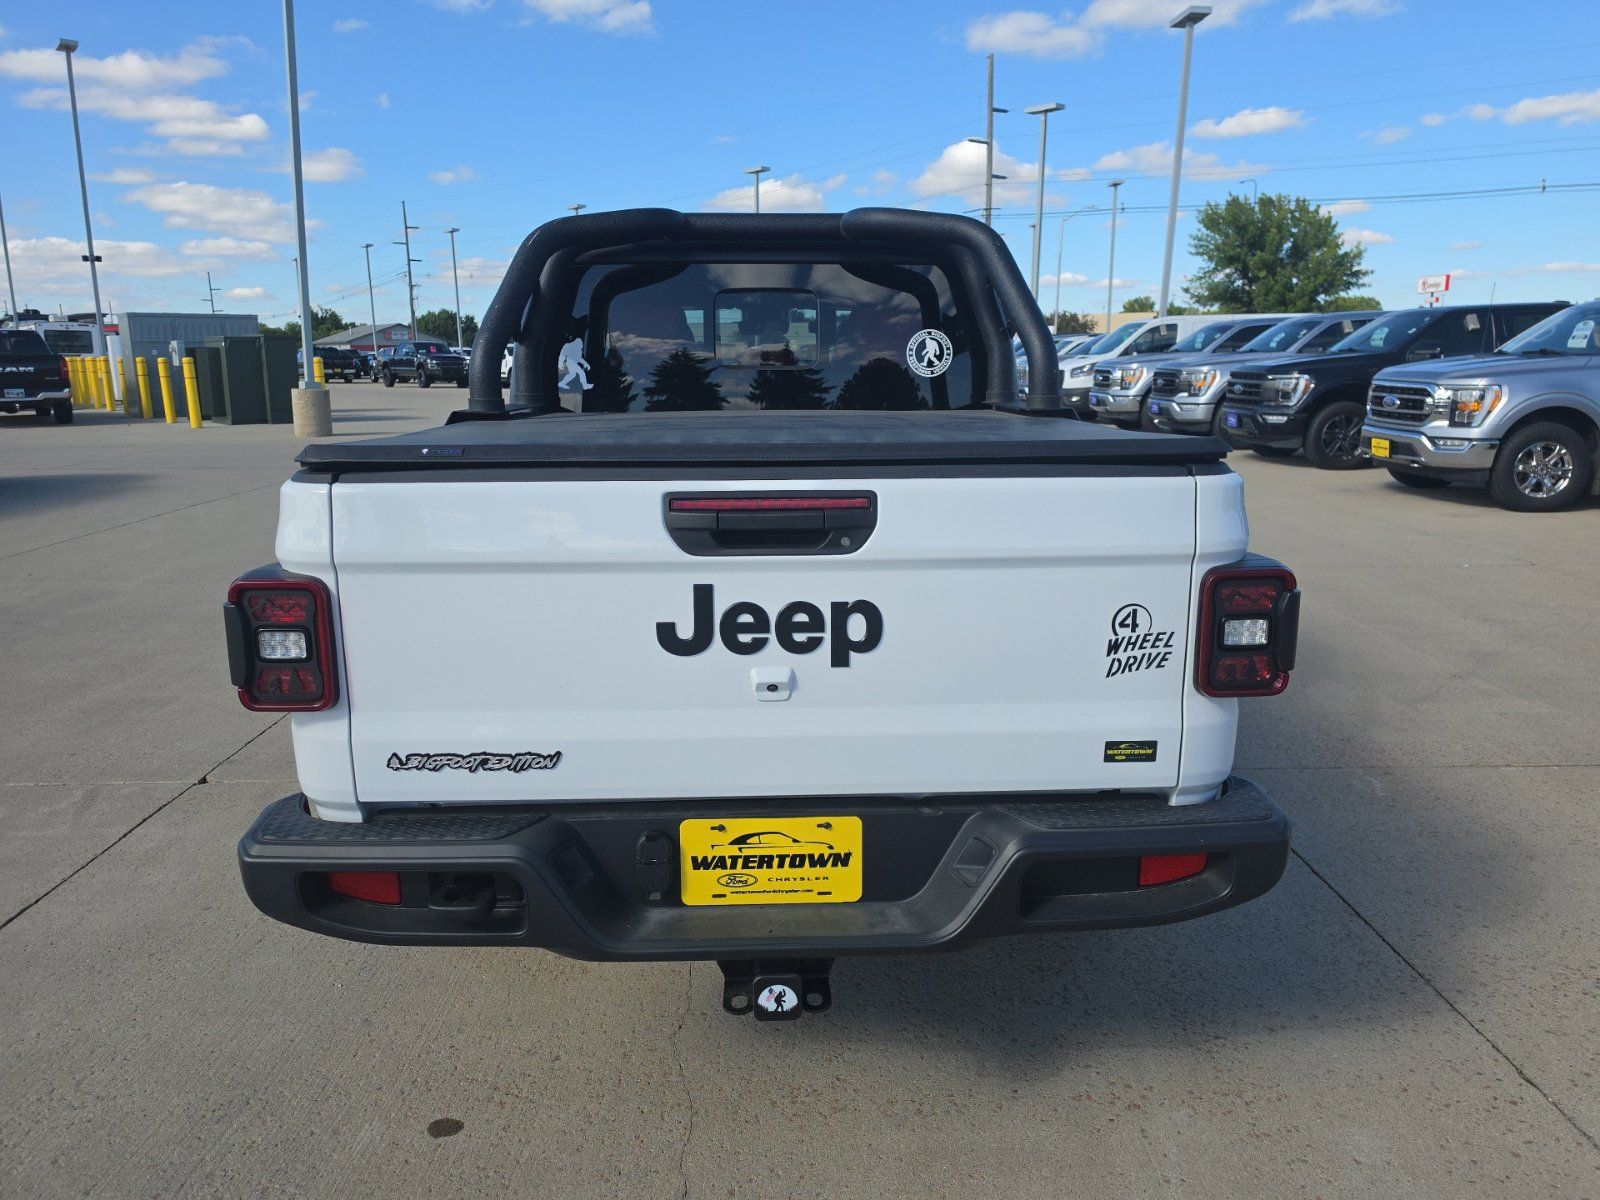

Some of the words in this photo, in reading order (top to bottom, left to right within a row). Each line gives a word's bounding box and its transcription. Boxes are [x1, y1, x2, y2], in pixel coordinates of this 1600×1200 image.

[910, 331, 929, 349] OFFICIAL
[931, 331, 950, 348] BIGFOOT
[656, 583, 883, 668] Jeep
[1118, 608, 1139, 633] 4
[1106, 631, 1175, 657] WHEEL
[1105, 651, 1172, 678] DRIVE
[405, 753, 484, 773] BIGFOOT
[483, 751, 562, 773] EDITION
[691, 852, 851, 871] WATERTOWN
